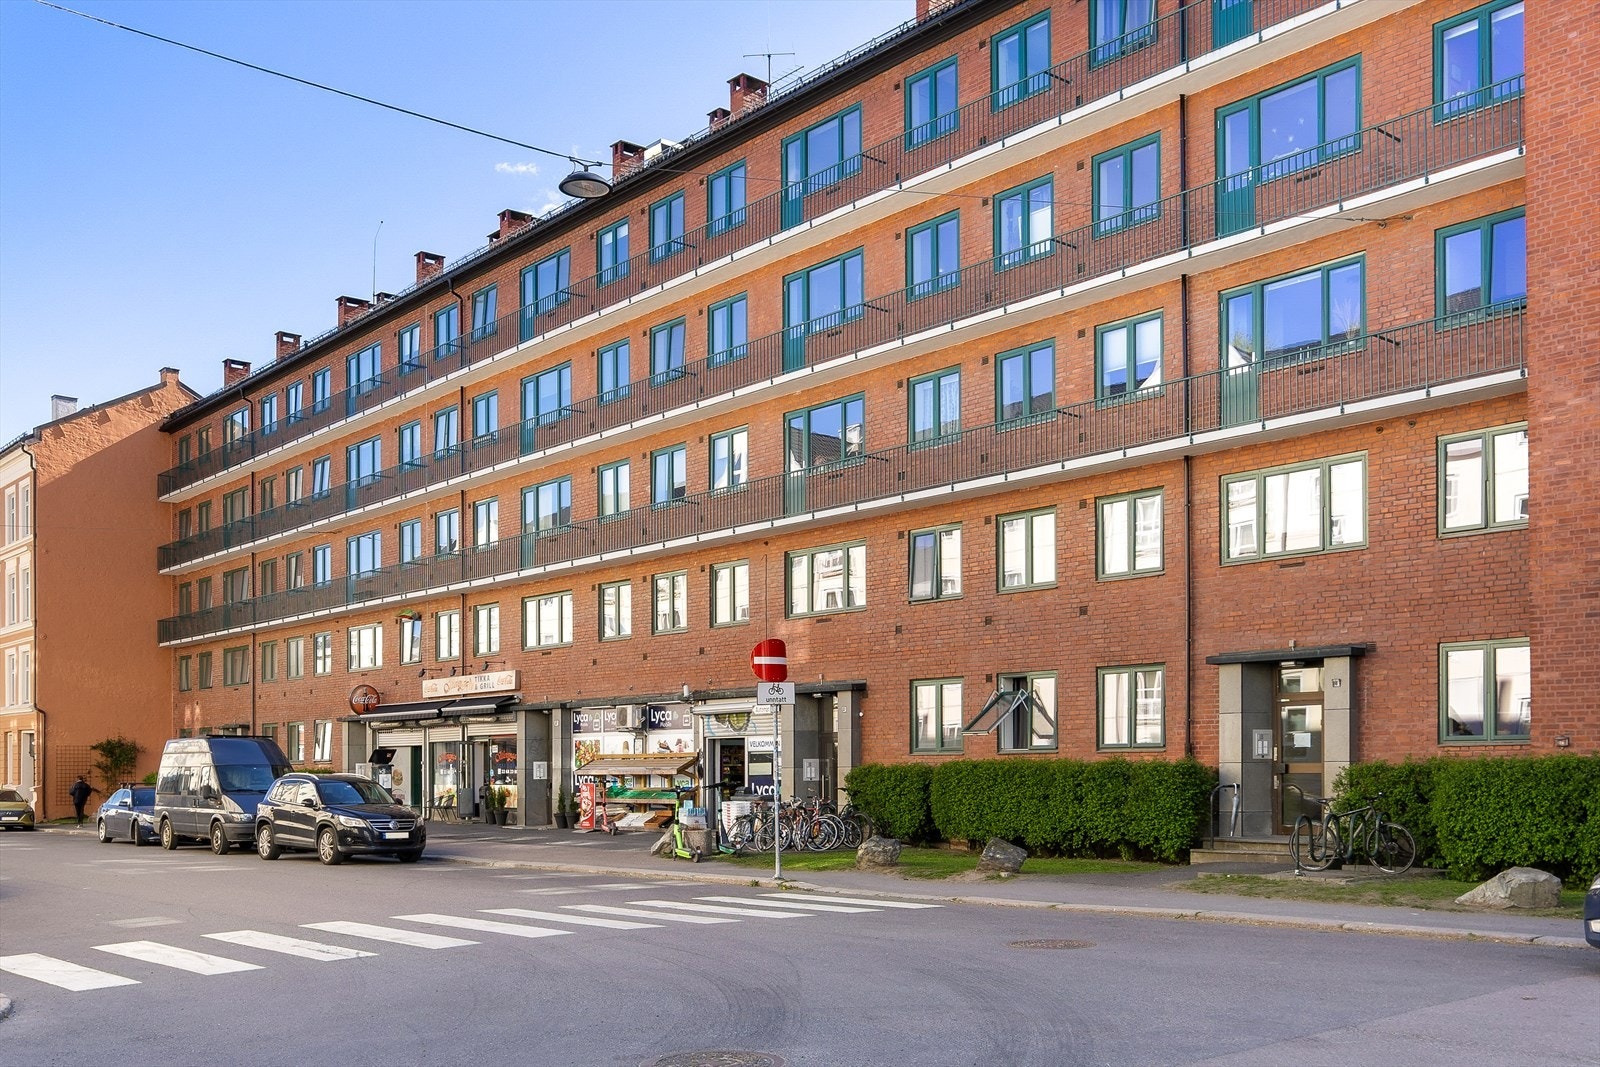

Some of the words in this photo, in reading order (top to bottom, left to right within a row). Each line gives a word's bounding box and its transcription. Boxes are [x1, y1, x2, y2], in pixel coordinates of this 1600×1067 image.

[480, 682, 495, 690] GRILL
[573, 713, 588, 725] Lyca
[650, 709, 672, 724] Lyca
[750, 740, 780, 748] VELKOMMN
